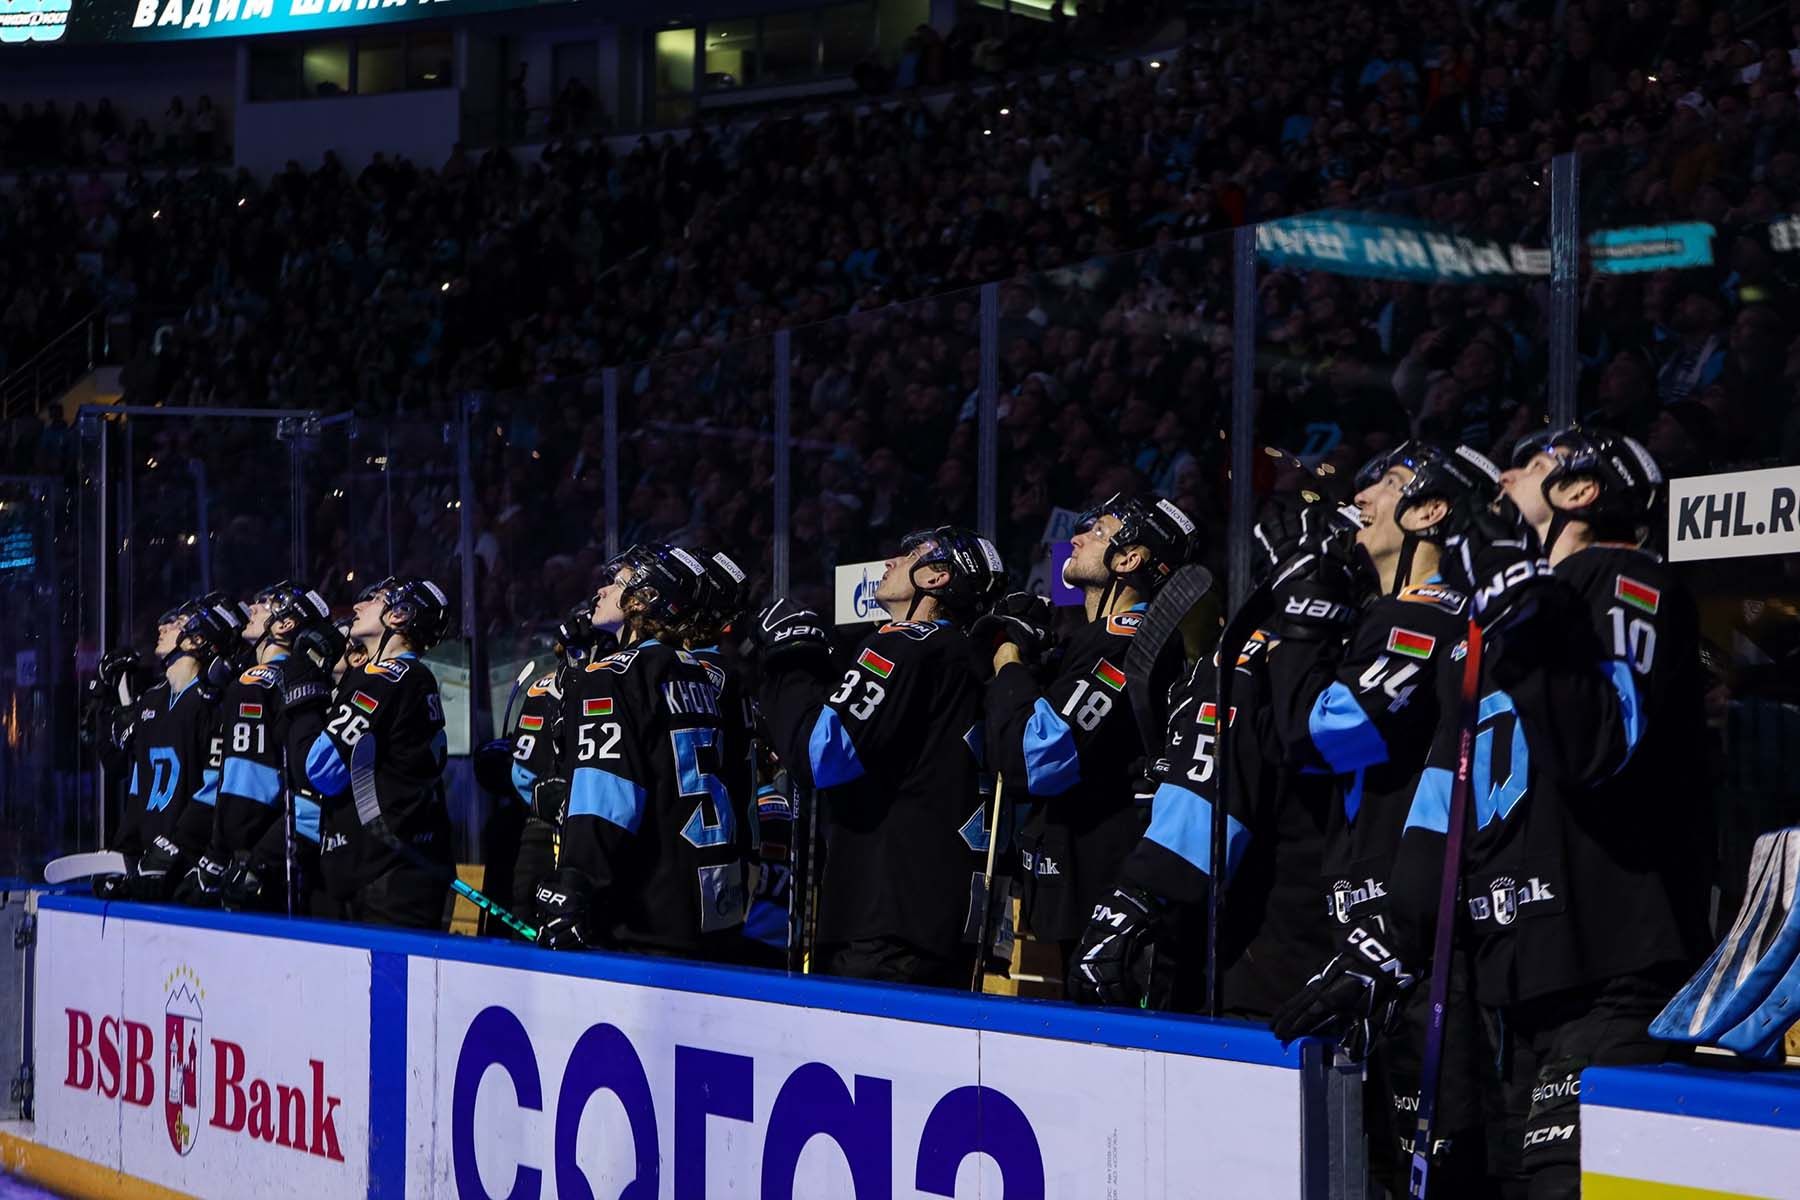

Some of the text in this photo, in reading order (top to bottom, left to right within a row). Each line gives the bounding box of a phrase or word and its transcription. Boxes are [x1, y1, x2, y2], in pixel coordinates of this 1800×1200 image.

[1677, 486, 1800, 542] KHL.R
[1606, 605, 1657, 676] 10
[829, 668, 887, 721] 33
[1060, 678, 1114, 732] 18
[232, 721, 265, 754] 81
[326, 703, 371, 747] 26
[577, 721, 623, 762] 52
[63, 1006, 346, 1163] BSB Bank
